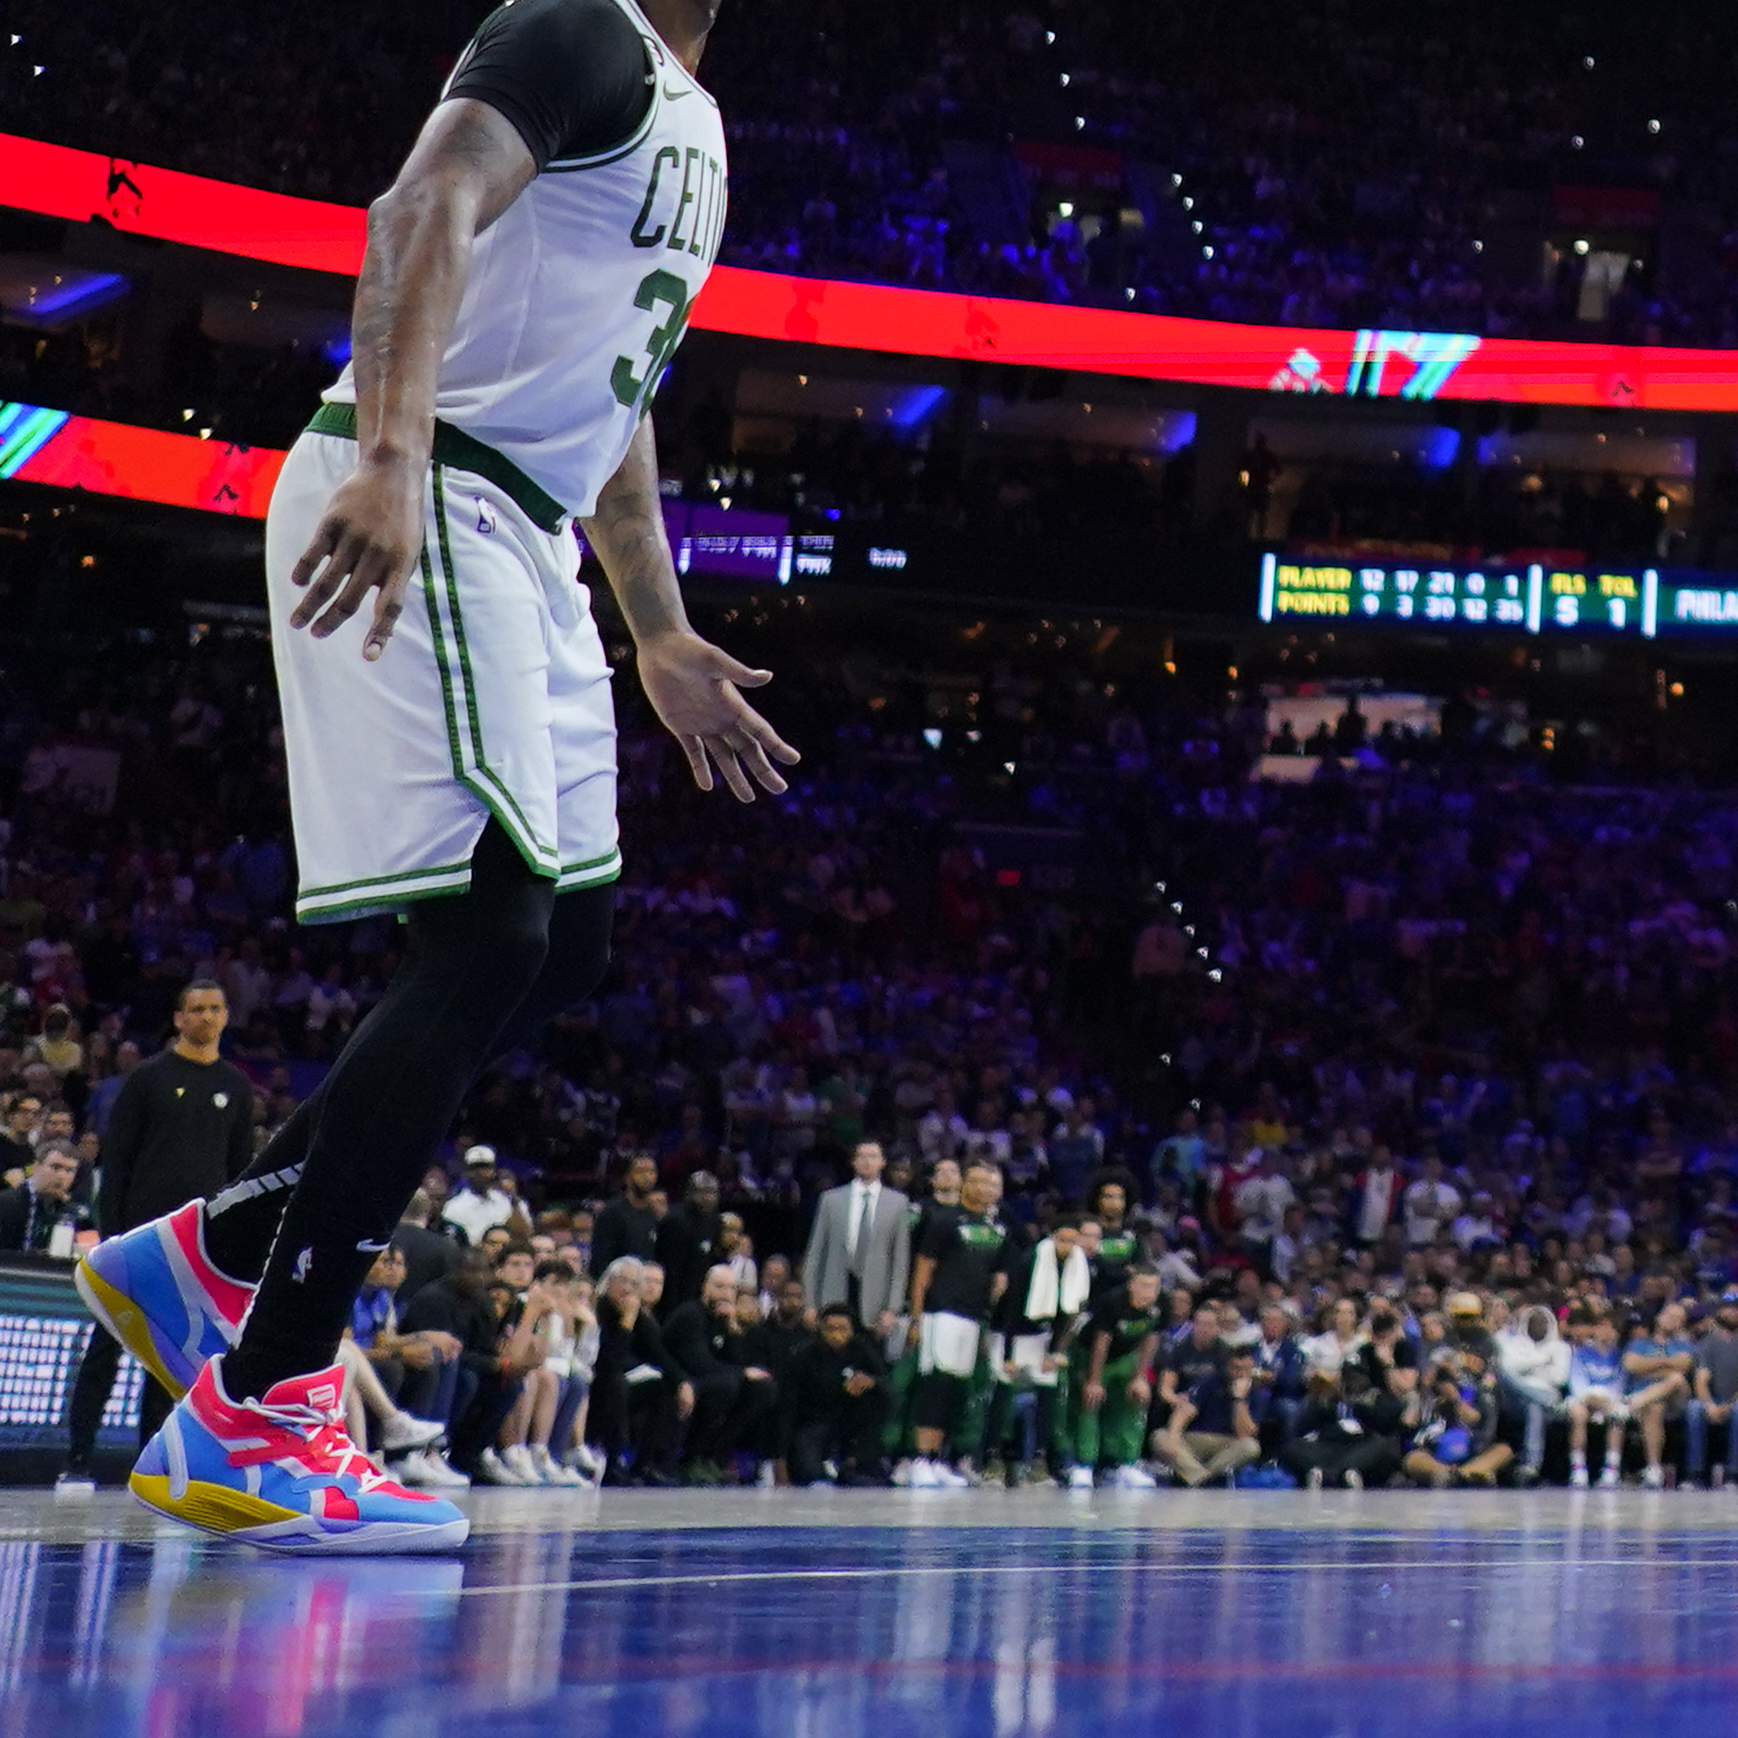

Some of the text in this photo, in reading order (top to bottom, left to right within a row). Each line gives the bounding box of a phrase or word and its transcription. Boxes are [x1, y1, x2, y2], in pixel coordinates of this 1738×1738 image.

[630, 146, 728, 268] CELTI
[1277, 565, 1352, 590] PLAYER
[1504, 574, 1519, 597] 1
[1597, 574, 1638, 598] TOL
[1277, 590, 1350, 616] POINTS
[1555, 594, 1627, 629] 5 1
